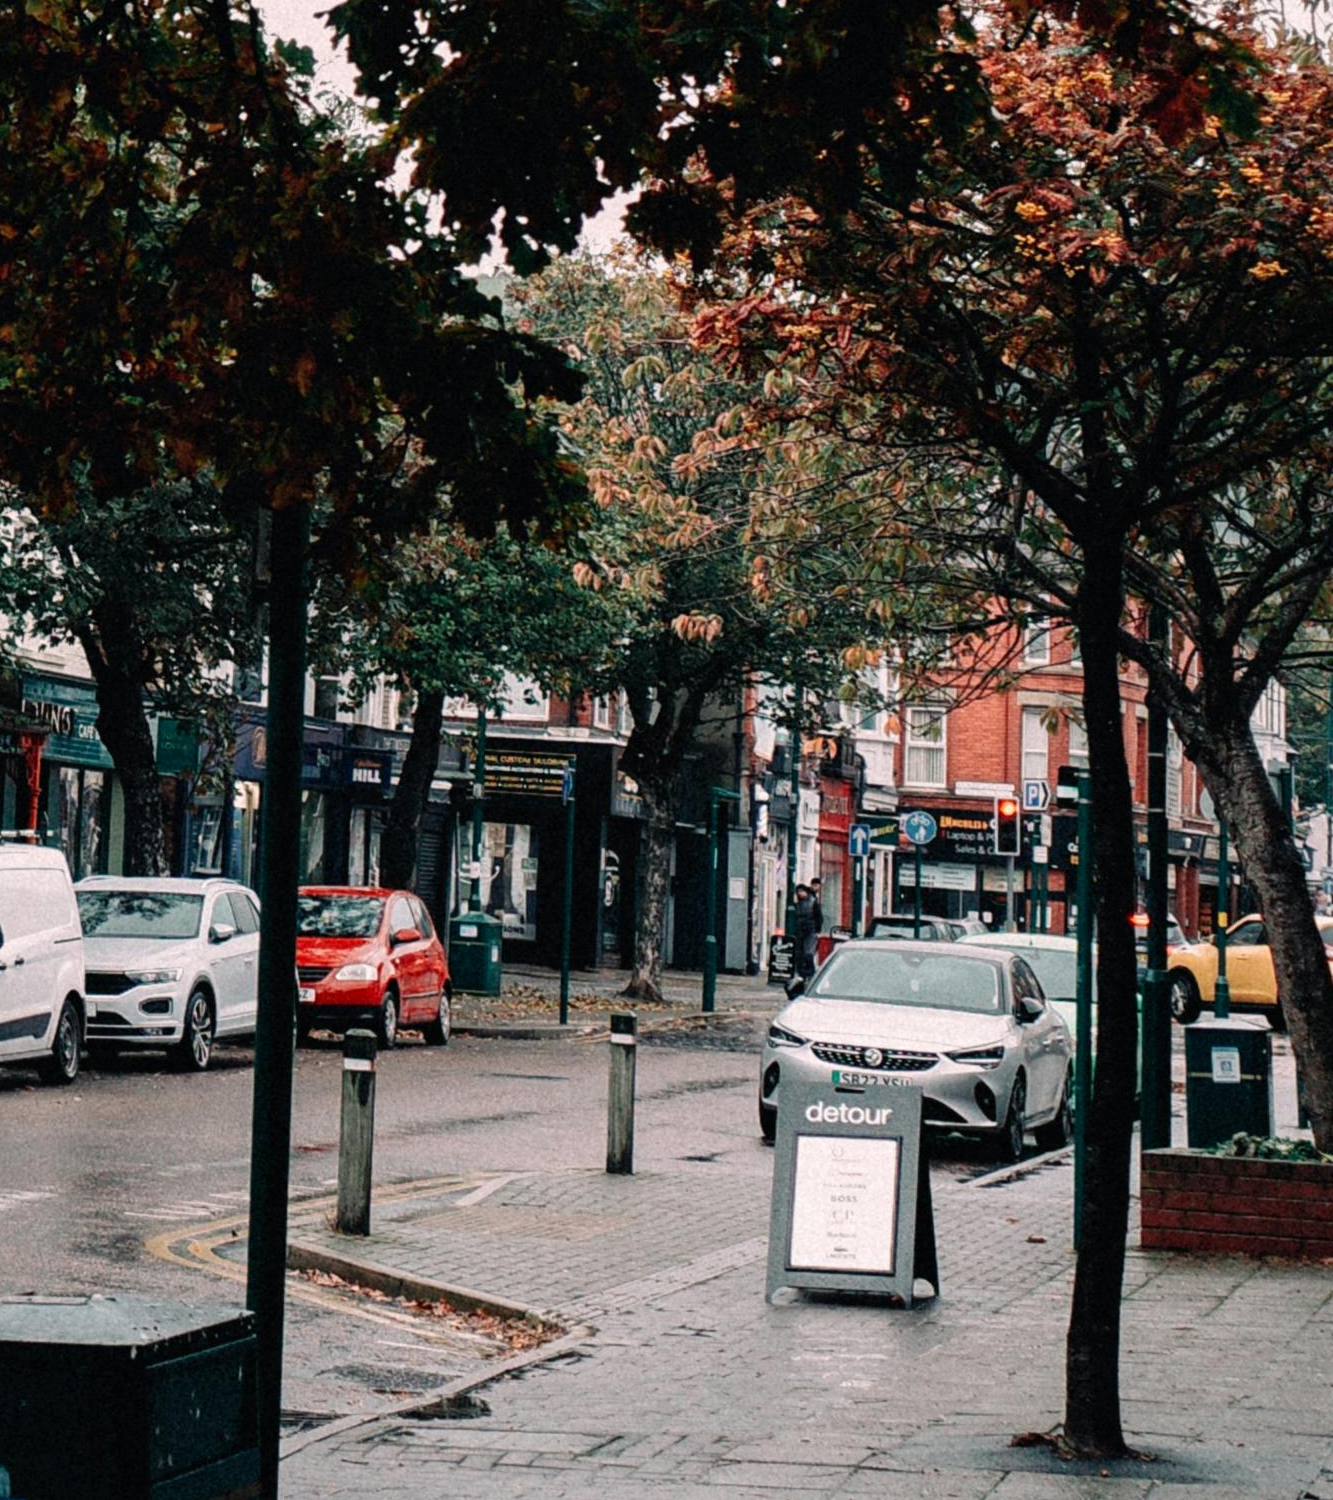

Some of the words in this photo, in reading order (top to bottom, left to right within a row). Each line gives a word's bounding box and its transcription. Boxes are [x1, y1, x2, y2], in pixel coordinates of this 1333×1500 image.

[352, 768, 381, 783] HILL
[1028, 785, 1037, 805] P
[805, 1101, 893, 1125] detour
